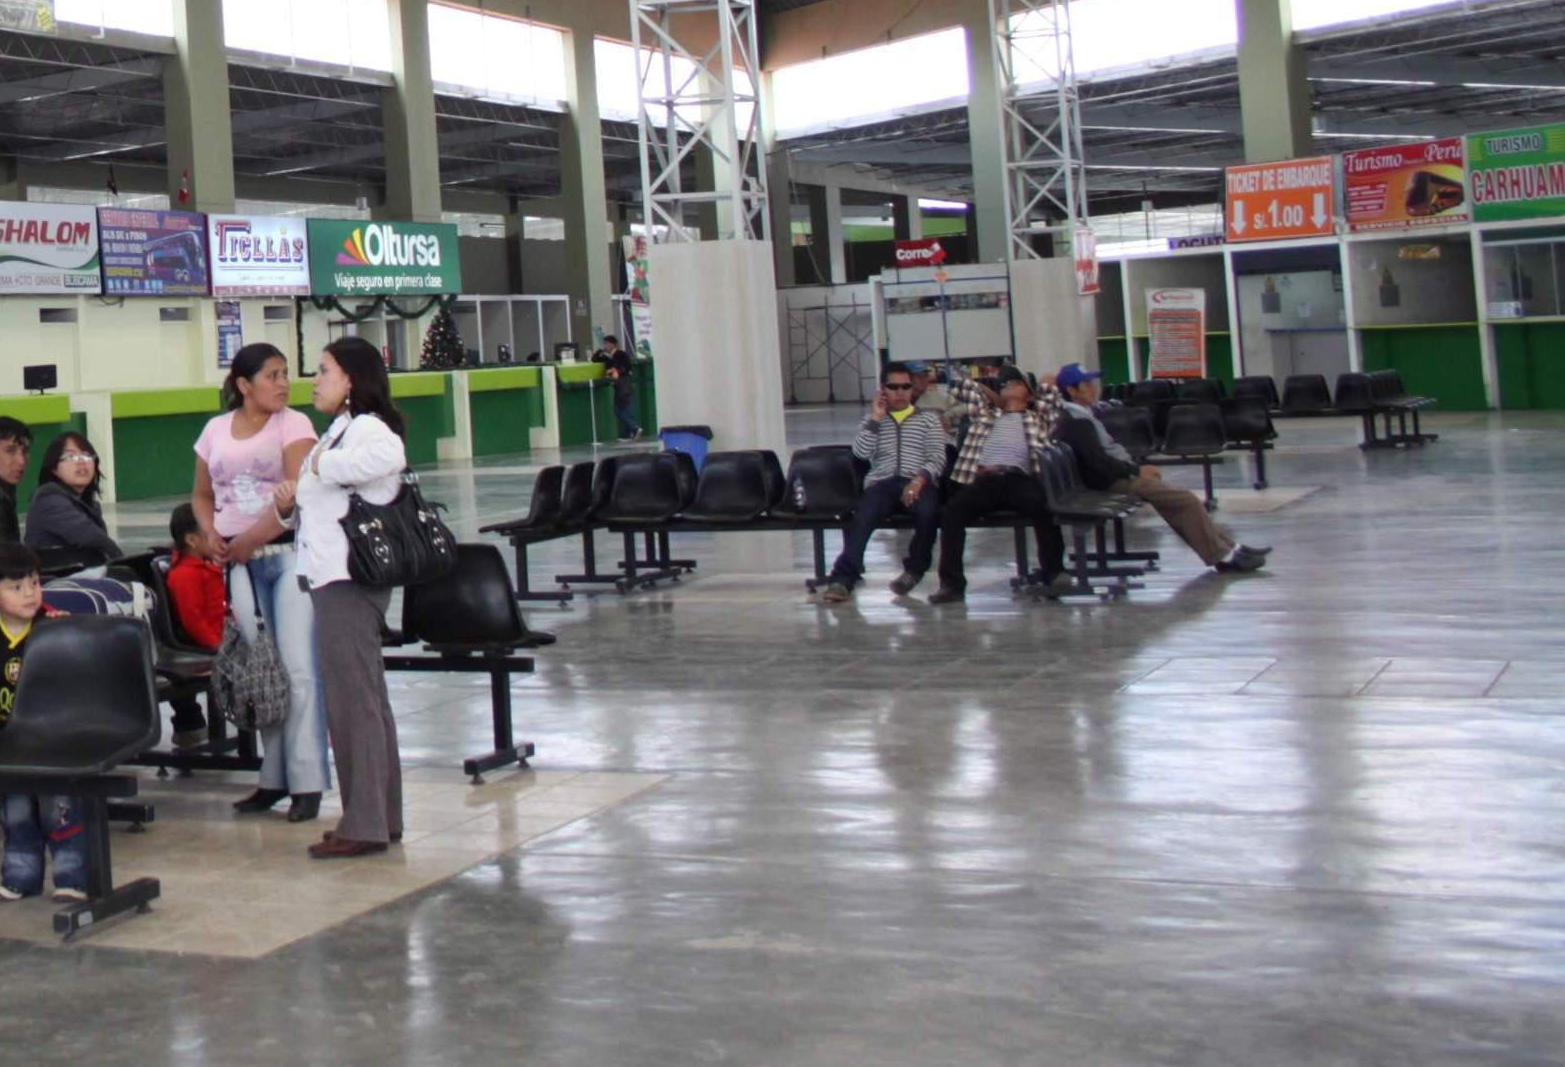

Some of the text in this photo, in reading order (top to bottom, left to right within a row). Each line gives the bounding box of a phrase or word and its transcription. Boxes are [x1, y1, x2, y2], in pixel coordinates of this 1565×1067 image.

[1344, 140, 1461, 172] Turismo Perú
[1488, 133, 1542, 153] TURISMO
[1226, 163, 1332, 193] TICKET DE EMBARQUE
[1472, 162, 1565, 203] CARHUAM
[364, 223, 441, 266] Oltursa
[1168, 234, 1226, 250] LOCUT
[334, 273, 443, 292] Viaje seguro en primera clase
